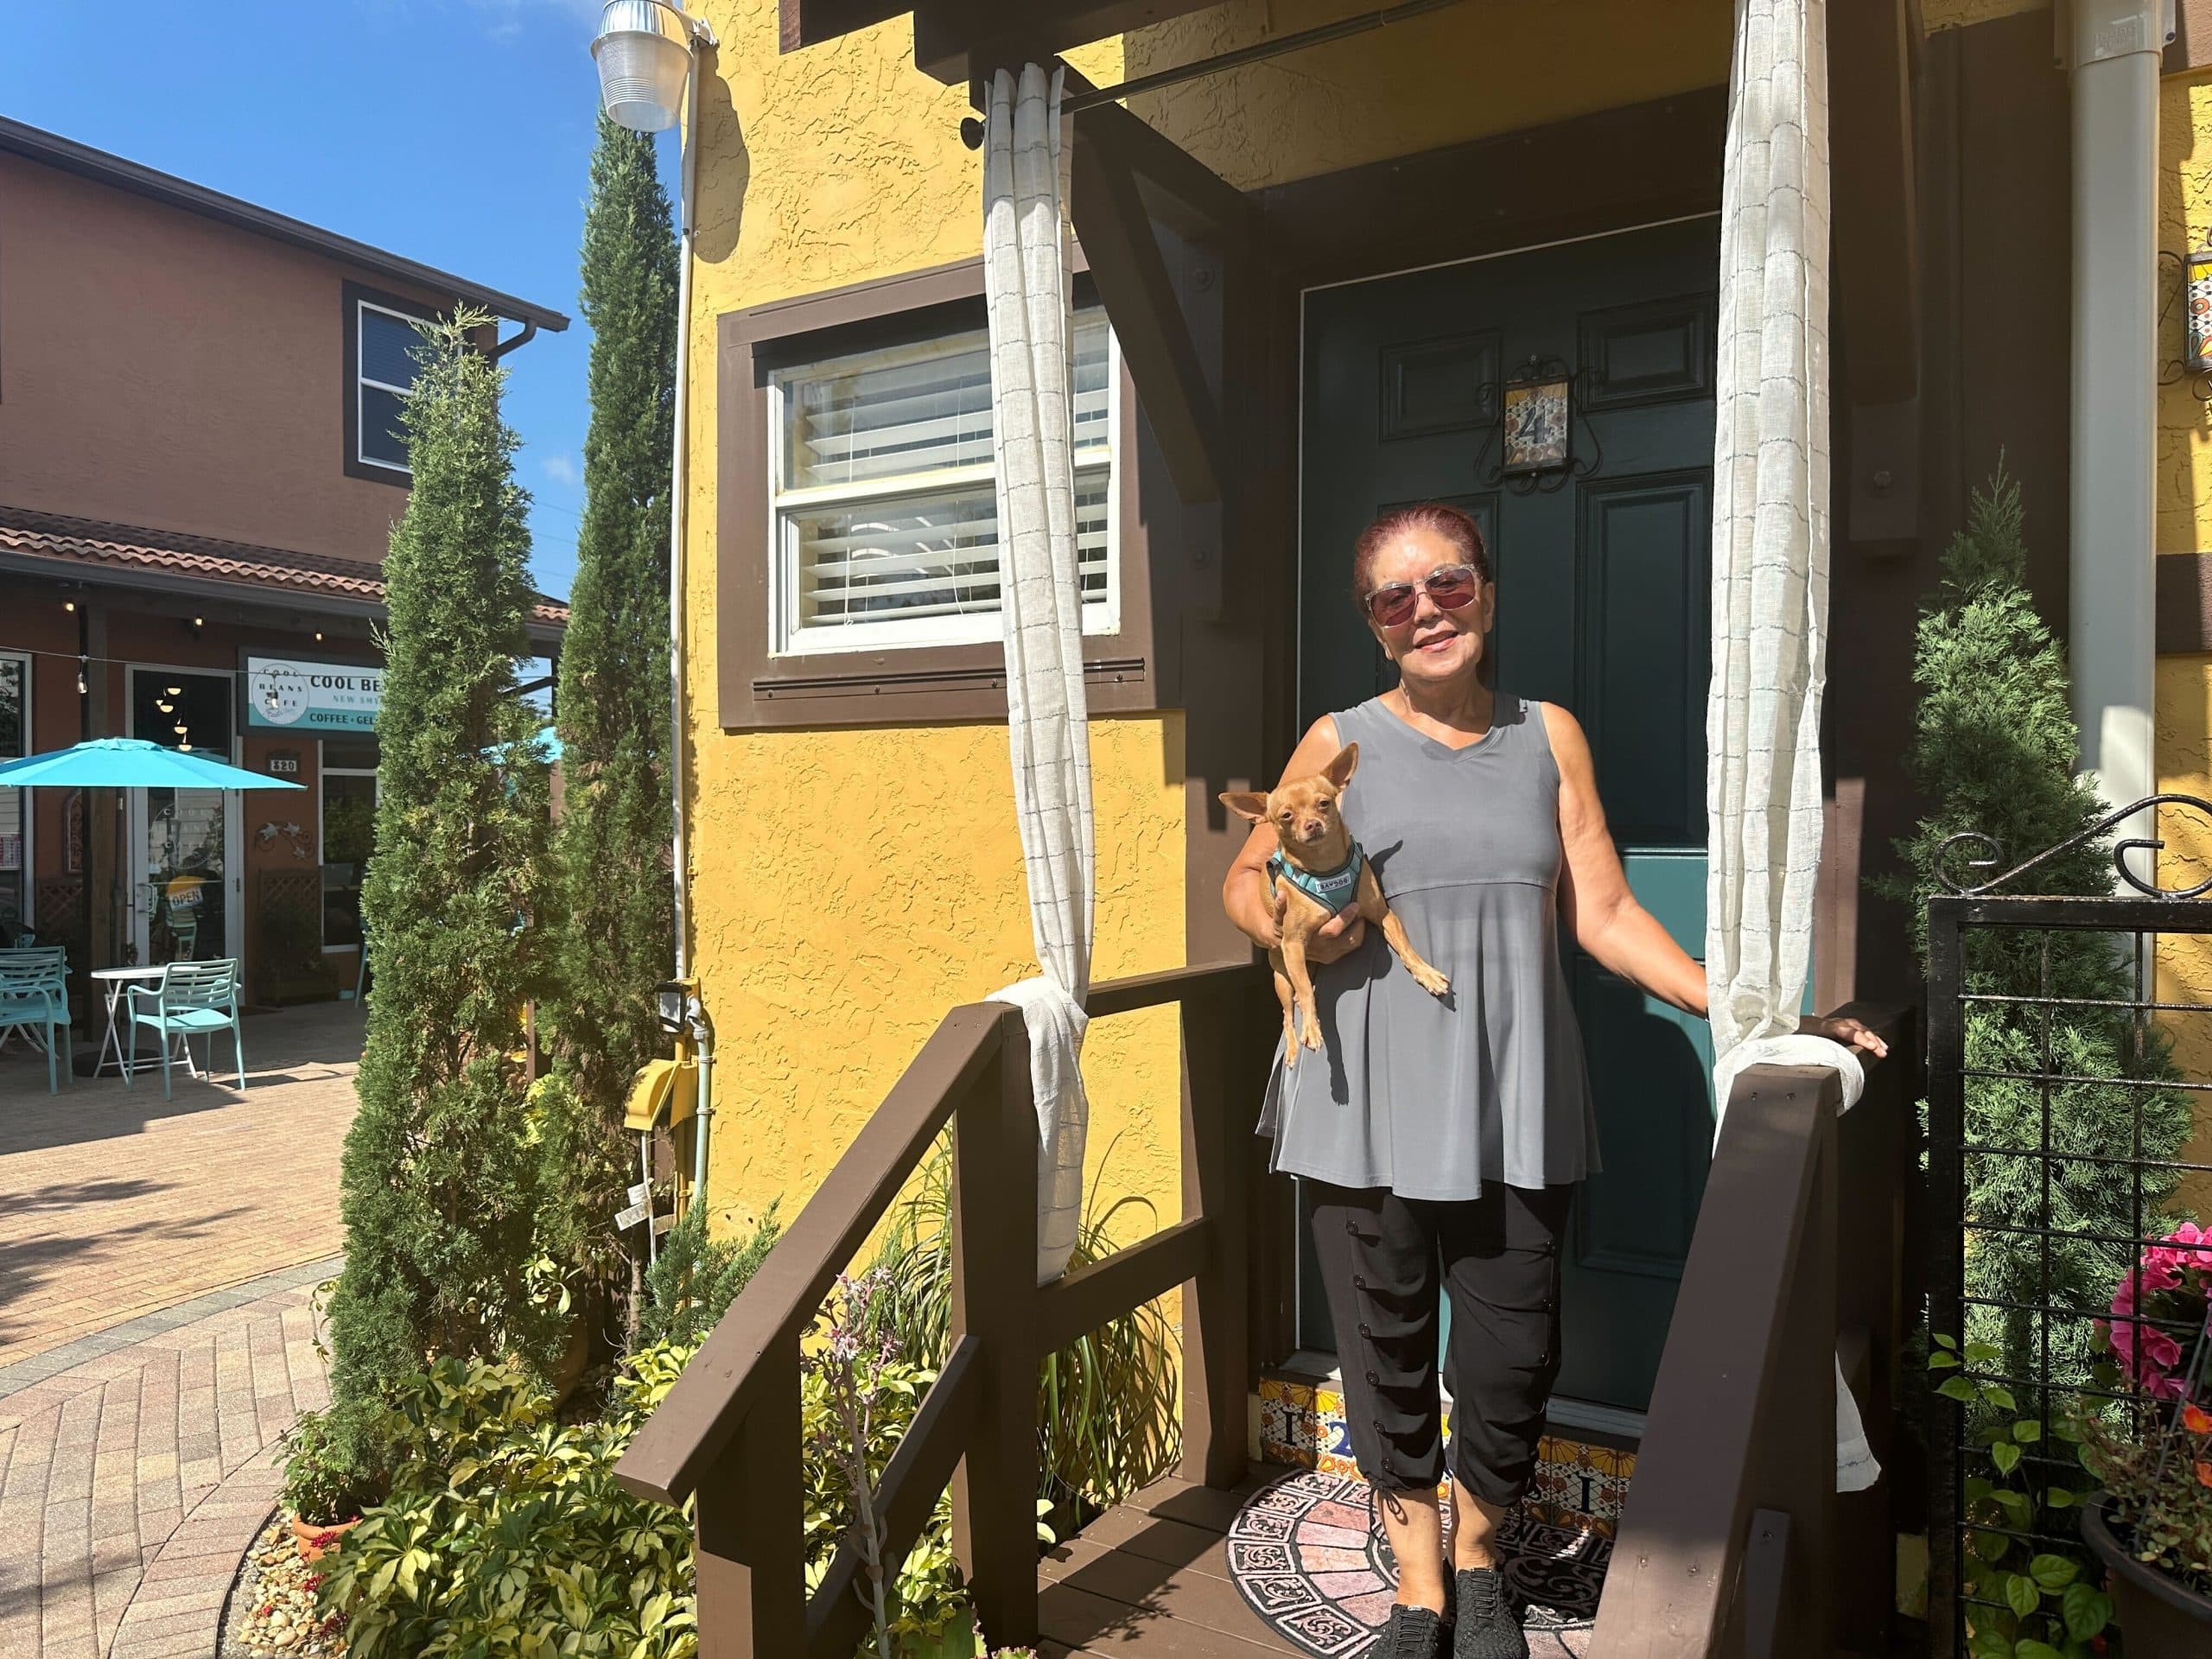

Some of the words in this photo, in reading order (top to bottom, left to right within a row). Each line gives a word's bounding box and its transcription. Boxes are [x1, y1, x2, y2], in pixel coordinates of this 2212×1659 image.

[1520, 406, 1551, 444] 4
[263, 669, 299, 677] COOL
[259, 683, 302, 692] BEANS
[310, 676, 354, 690] COOL
[361, 679, 380, 692] BE
[334, 696, 354, 704] NEW
[309, 713, 347, 724] COFFEE
[357, 715, 375, 725] GEL
[172, 890, 200, 906] OPEN
[1329, 1421, 1354, 1459] 2
